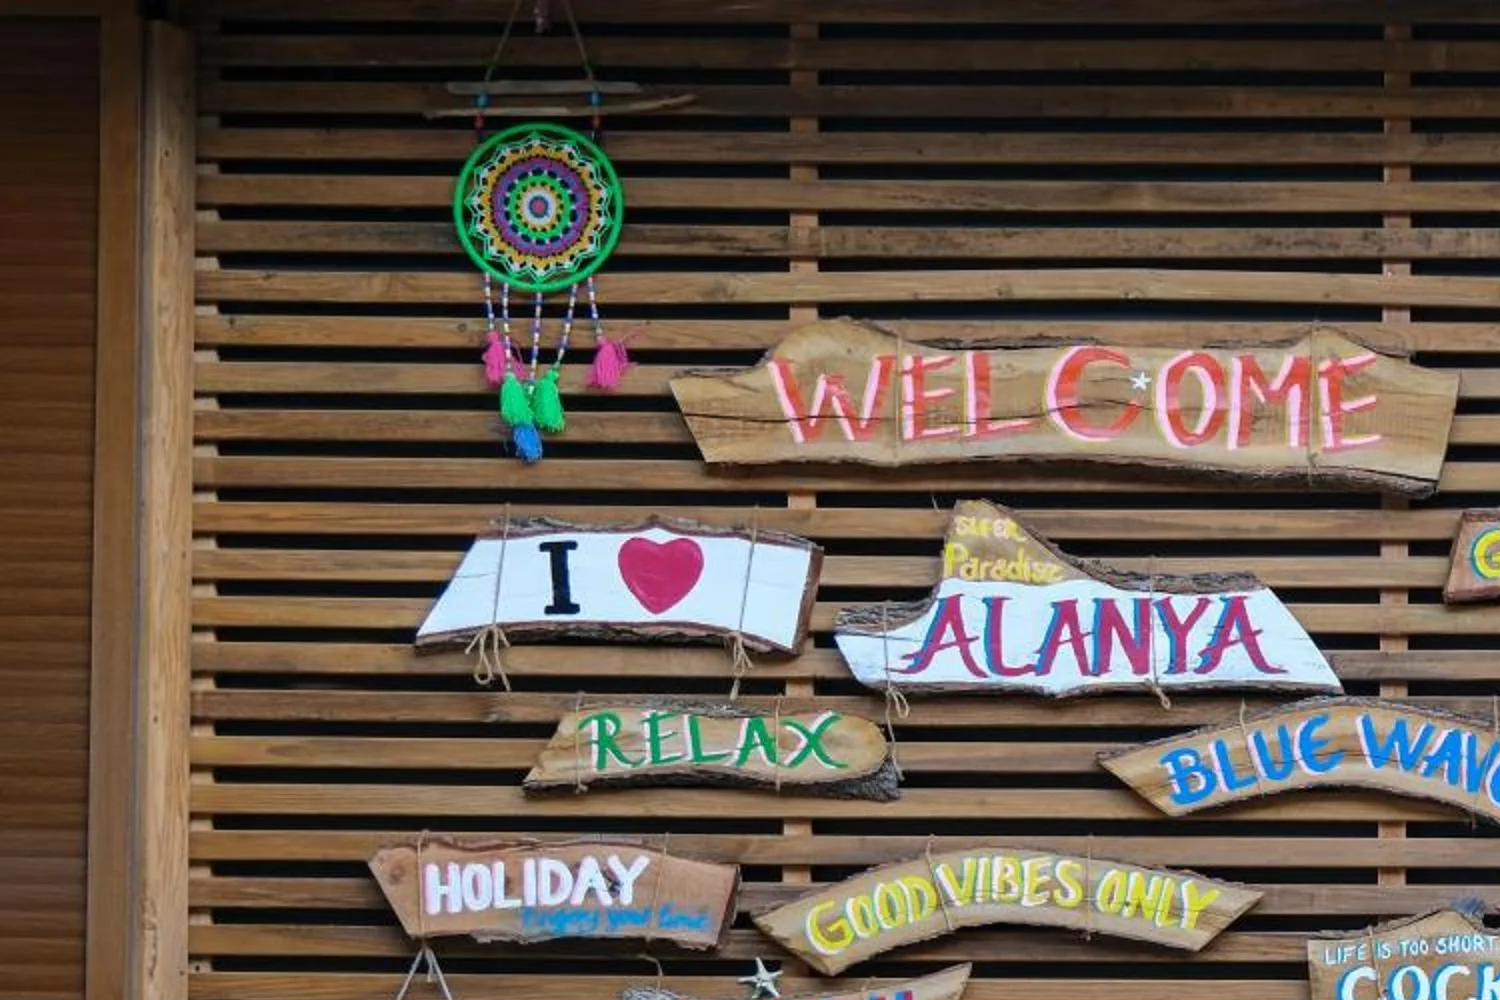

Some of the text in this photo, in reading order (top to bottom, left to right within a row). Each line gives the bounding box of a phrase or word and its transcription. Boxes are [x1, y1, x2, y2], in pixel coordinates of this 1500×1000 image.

[766, 345, 1383, 454] WELCOME
[539, 540, 580, 615] I
[886, 594, 1288, 678] ALANYA
[578, 709, 848, 771] RELAX
[1159, 713, 1346, 807] BLUE
[424, 854, 650, 915] HOLIDAY
[804, 853, 1220, 955] GOOD VIBES ONLY
[1321, 942, 1367, 965] LIFE
[1373, 943, 1392, 960] IS
[1399, 940, 1430, 958] TOO
